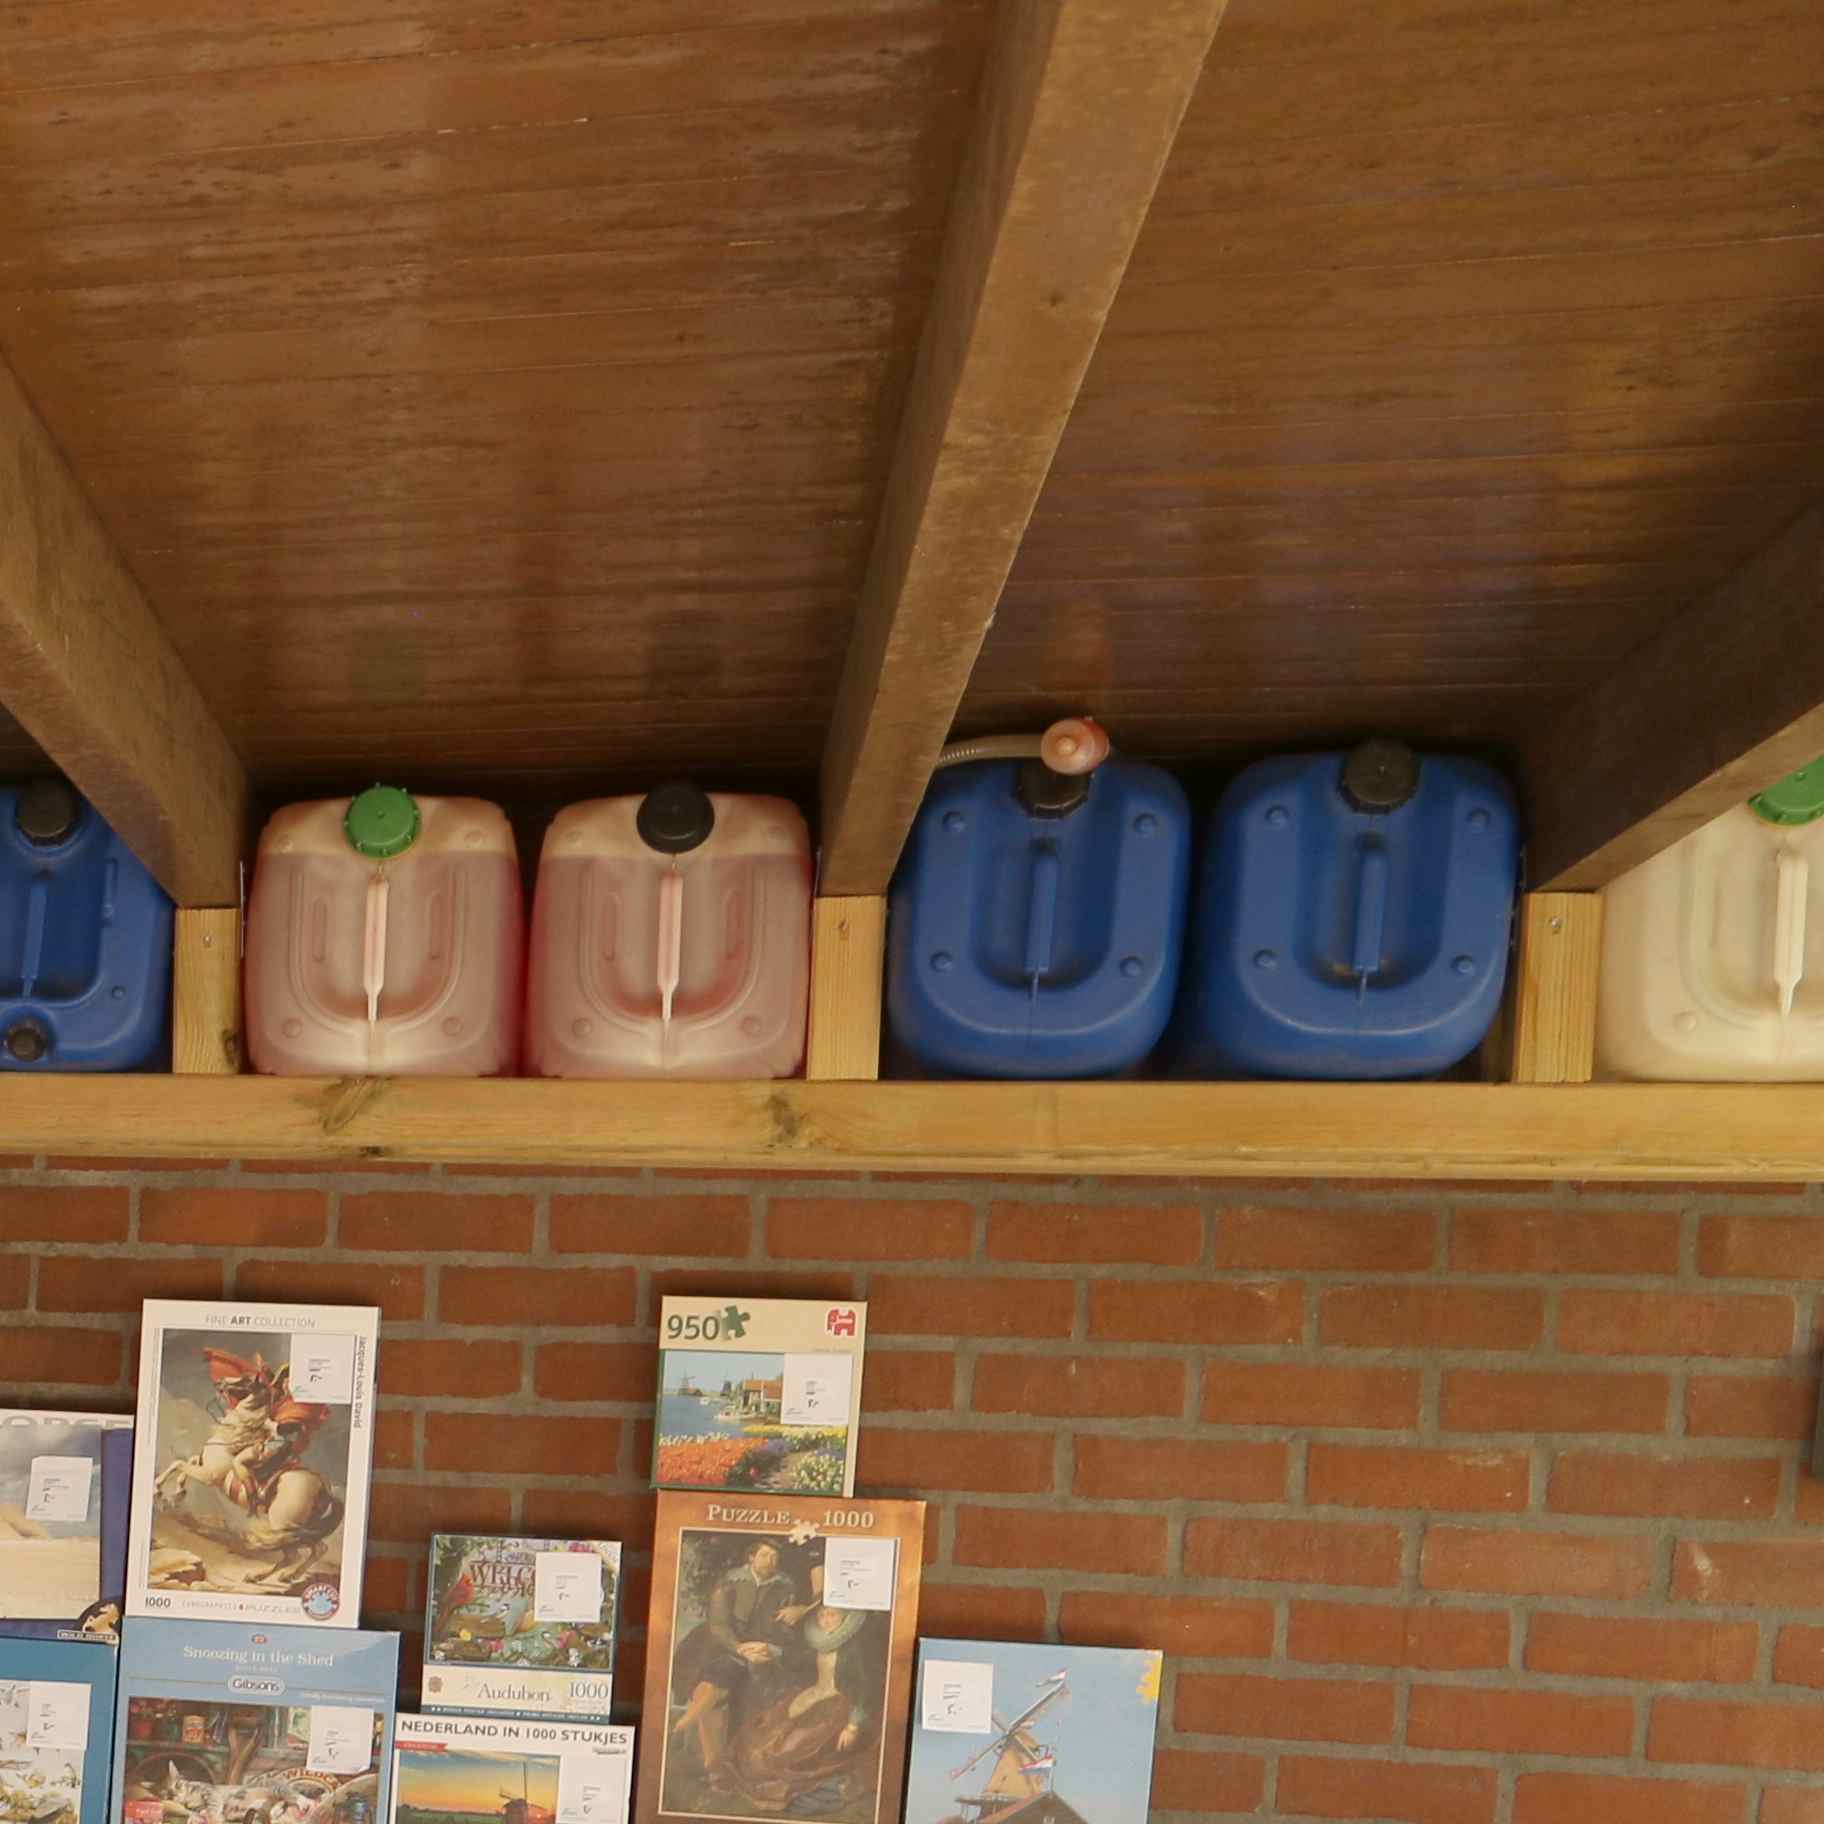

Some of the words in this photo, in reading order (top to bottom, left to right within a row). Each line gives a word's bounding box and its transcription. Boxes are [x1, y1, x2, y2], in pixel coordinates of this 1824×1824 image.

[231, 1316, 251, 1325] ART
[254, 1318, 316, 1328] COLLECTION
[667, 1315, 720, 1341] 950
[823, 1510, 874, 1529] 1000
[144, 1598, 171, 1608] 1000
[183, 1646, 249, 1664] Snoozing
[252, 1651, 266, 1662] in
[270, 1651, 294, 1664] the
[298, 1653, 334, 1667] Shed
[232, 1678, 279, 1692] Gibsons
[477, 1684, 551, 1701] Audubon
[568, 1681, 609, 1699] 1000
[401, 1719, 498, 1737] NEDERLAND
[503, 1727, 520, 1738] IN
[525, 1728, 556, 1739] 1000
[561, 1730, 628, 1746] STUKJES
